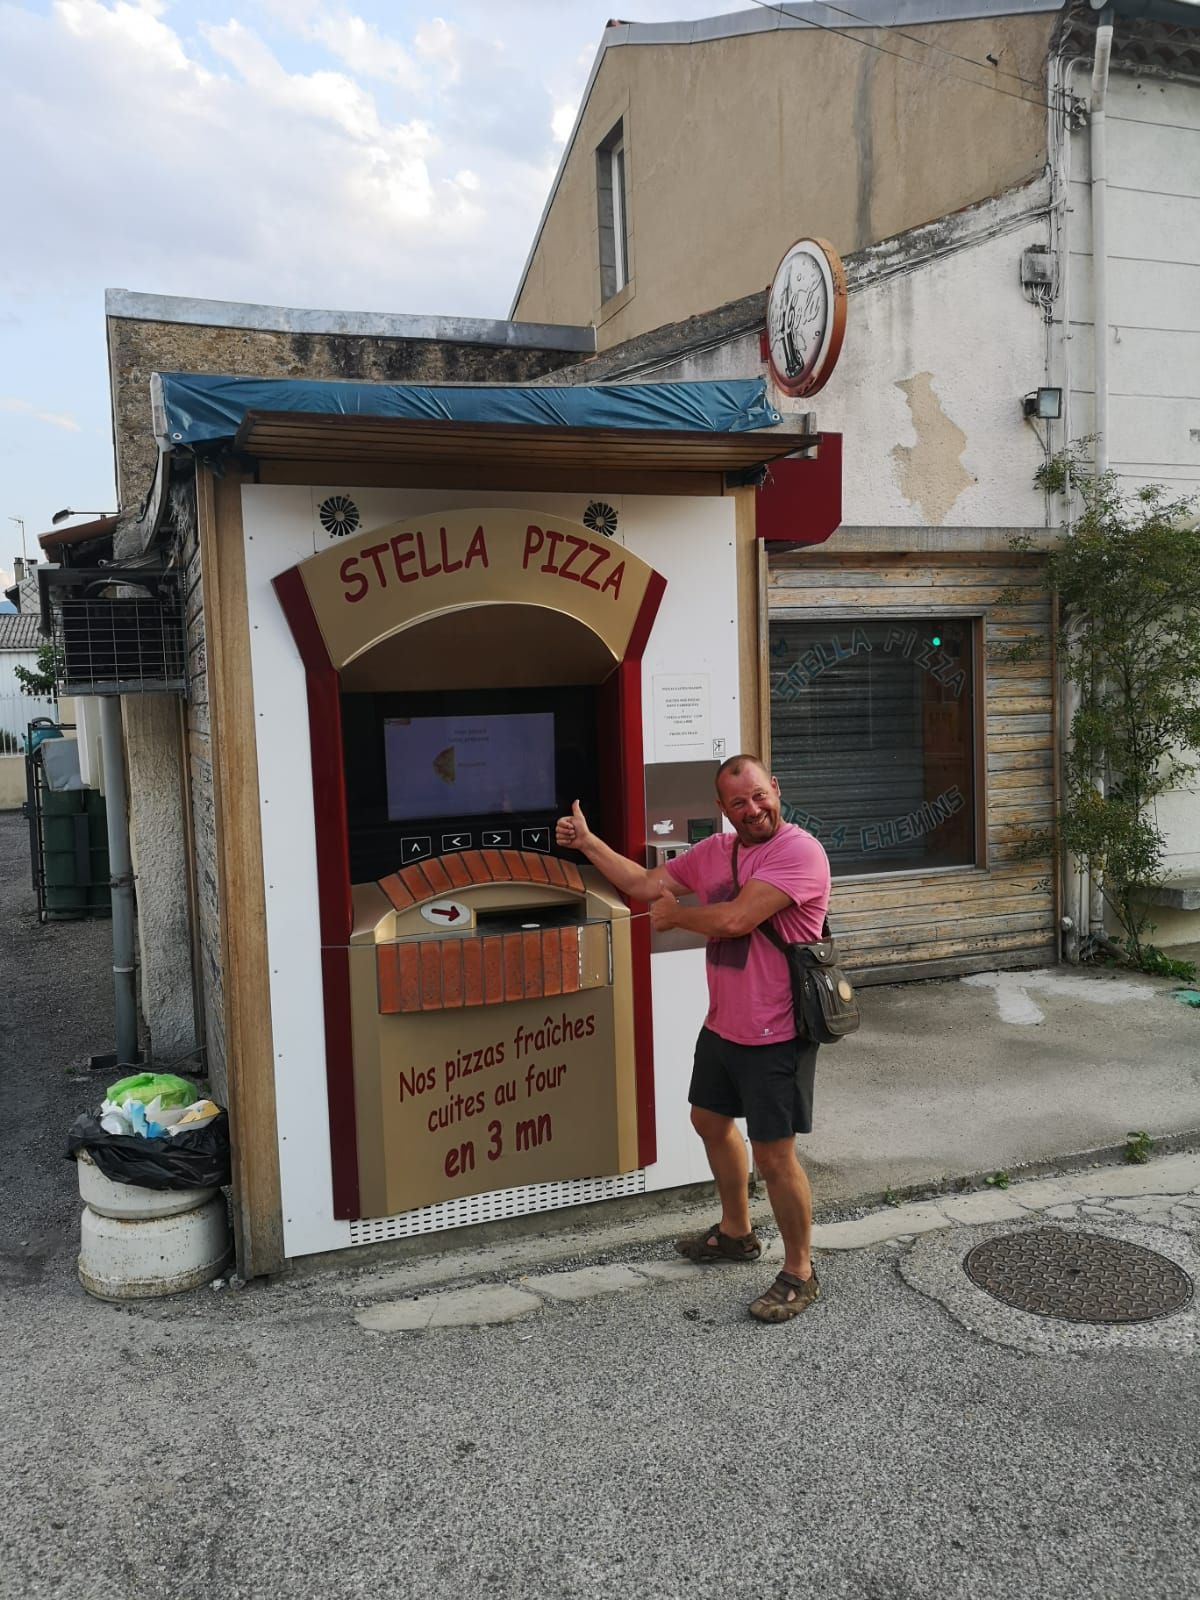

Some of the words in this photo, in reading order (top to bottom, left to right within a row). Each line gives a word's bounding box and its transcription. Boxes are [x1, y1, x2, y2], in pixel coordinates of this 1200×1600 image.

[339, 526, 489, 604] STELLA
[522, 525, 626, 601] PIZZA
[776, 628, 872, 702] STELLA
[884, 626, 966, 698] PIZZA
[831, 825, 848, 849] 4
[399, 1067, 437, 1103] Nos
[444, 1043, 505, 1092] pizzas
[513, 1013, 594, 1058] fraîches
[428, 1091, 486, 1133] cuites
[493, 1081, 517, 1106] au
[525, 1065, 567, 1096] four
[443, 1139, 475, 1178] en
[487, 1119, 503, 1161] 3
[515, 1113, 552, 1152] mn
